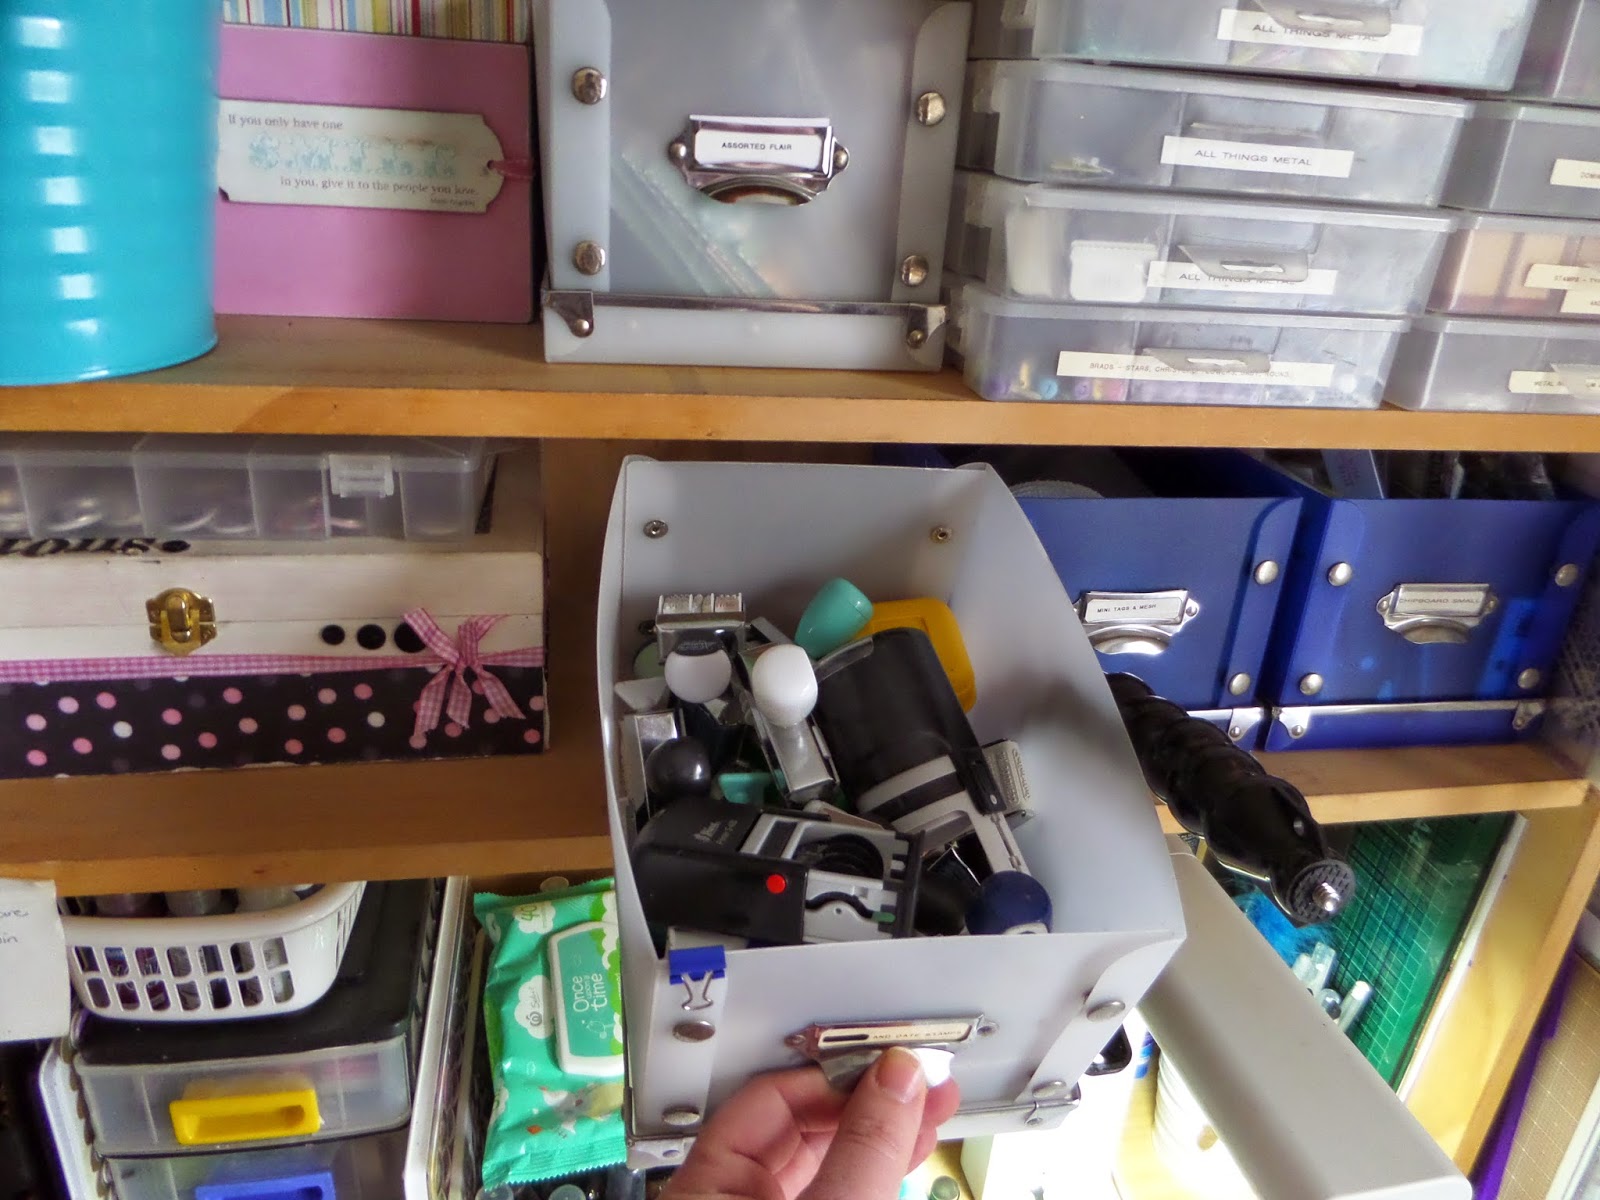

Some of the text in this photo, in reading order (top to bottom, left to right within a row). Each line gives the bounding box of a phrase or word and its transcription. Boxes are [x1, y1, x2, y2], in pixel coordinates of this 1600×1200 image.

[1252, 24, 1275, 33] ALL
[240, 117, 261, 128] you
[265, 117, 289, 128] only
[293, 118, 319, 128] have
[322, 121, 343, 129] one
[721, 142, 766, 150] ASSORTED
[1194, 150, 1312, 165] ALL THINGS METAL
[321, 179, 343, 189] give
[347, 179, 355, 189] it
[358, 180, 369, 189] to
[372, 182, 389, 191] the
[393, 184, 428, 194] people
[431, 186, 451, 194] you
[1179, 273, 1201, 281] ALL
[1089, 362, 1114, 370] BRADS
[572, 975, 590, 1012] Once
[591, 973, 608, 1012] time
